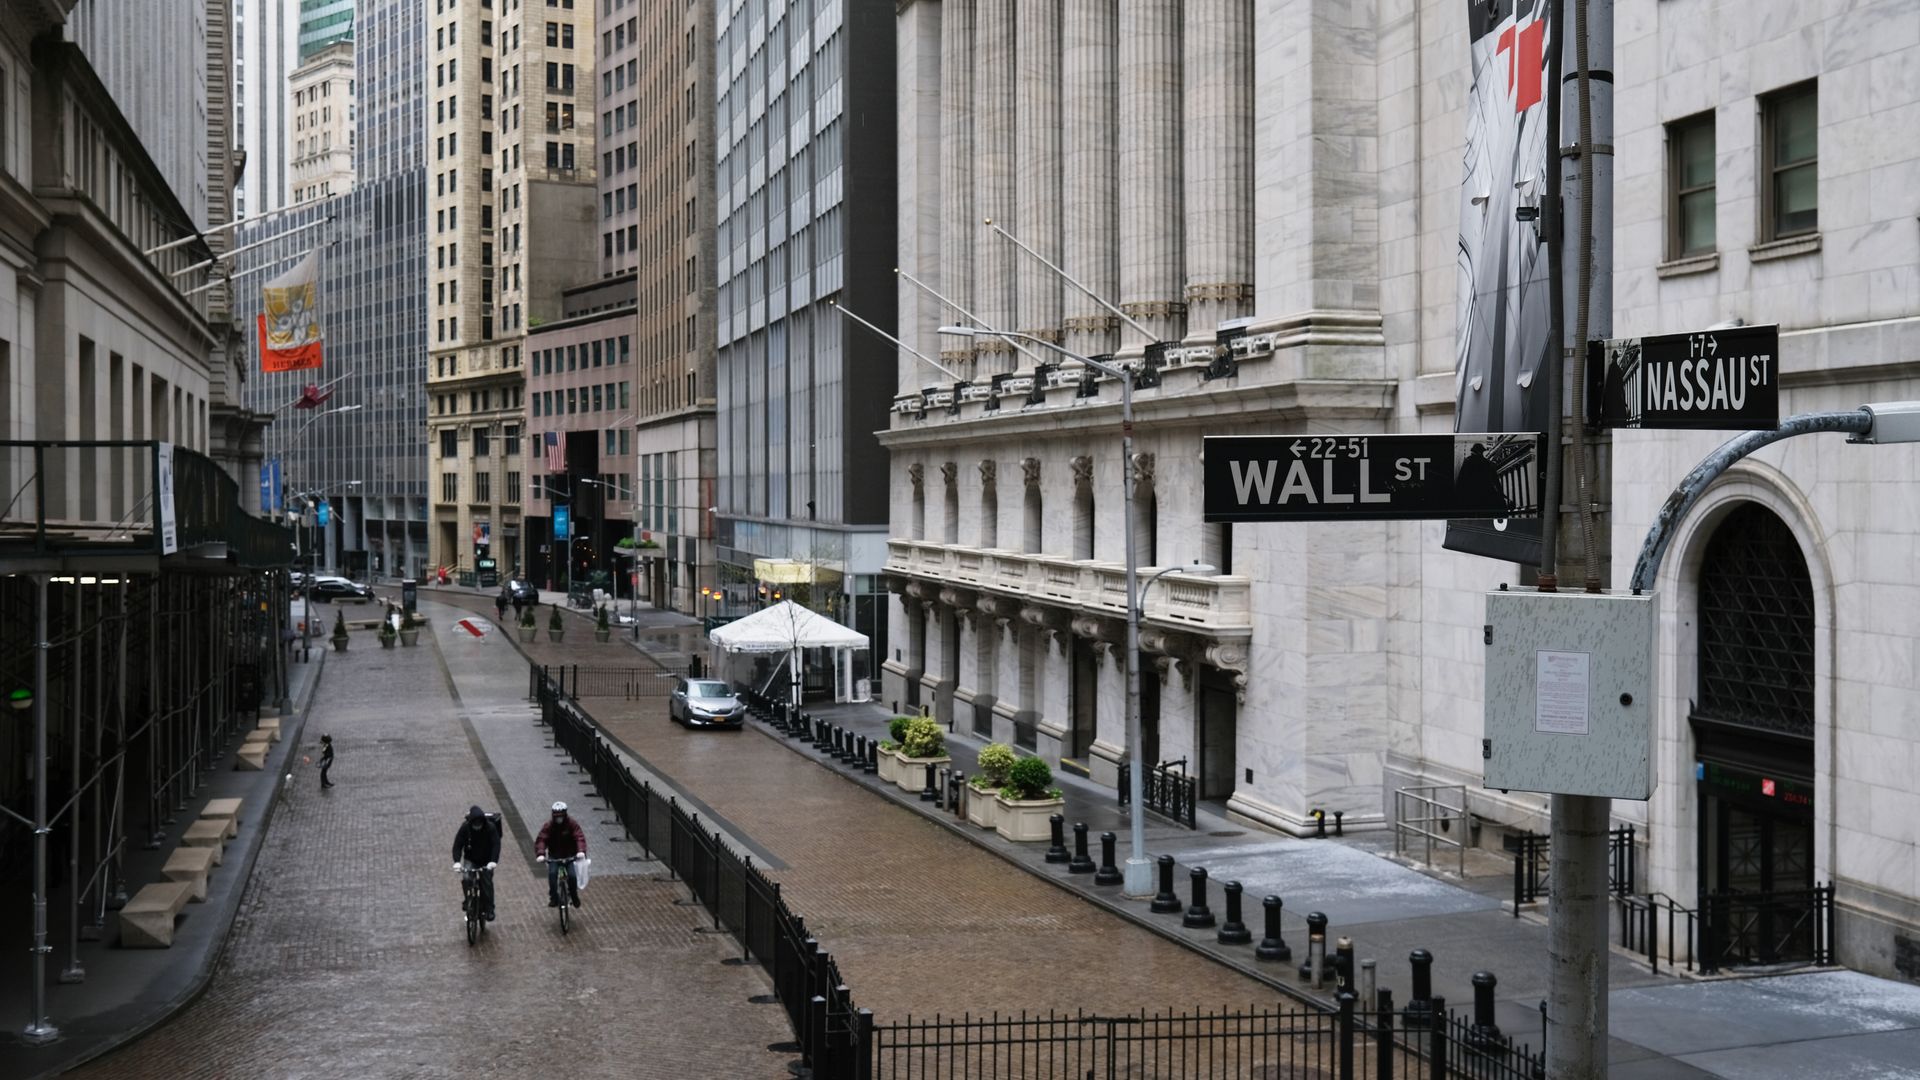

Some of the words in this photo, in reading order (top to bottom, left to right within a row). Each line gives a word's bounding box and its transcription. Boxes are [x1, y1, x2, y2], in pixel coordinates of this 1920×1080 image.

[1689, 334, 1705, 358] 1-7
[1647, 356, 1746, 411] NASSAU
[1750, 354, 1770, 386] ST
[1310, 437, 1369, 459] 22-51
[1229, 458, 1391, 505] WALL
[1394, 457, 1431, 481] ST
